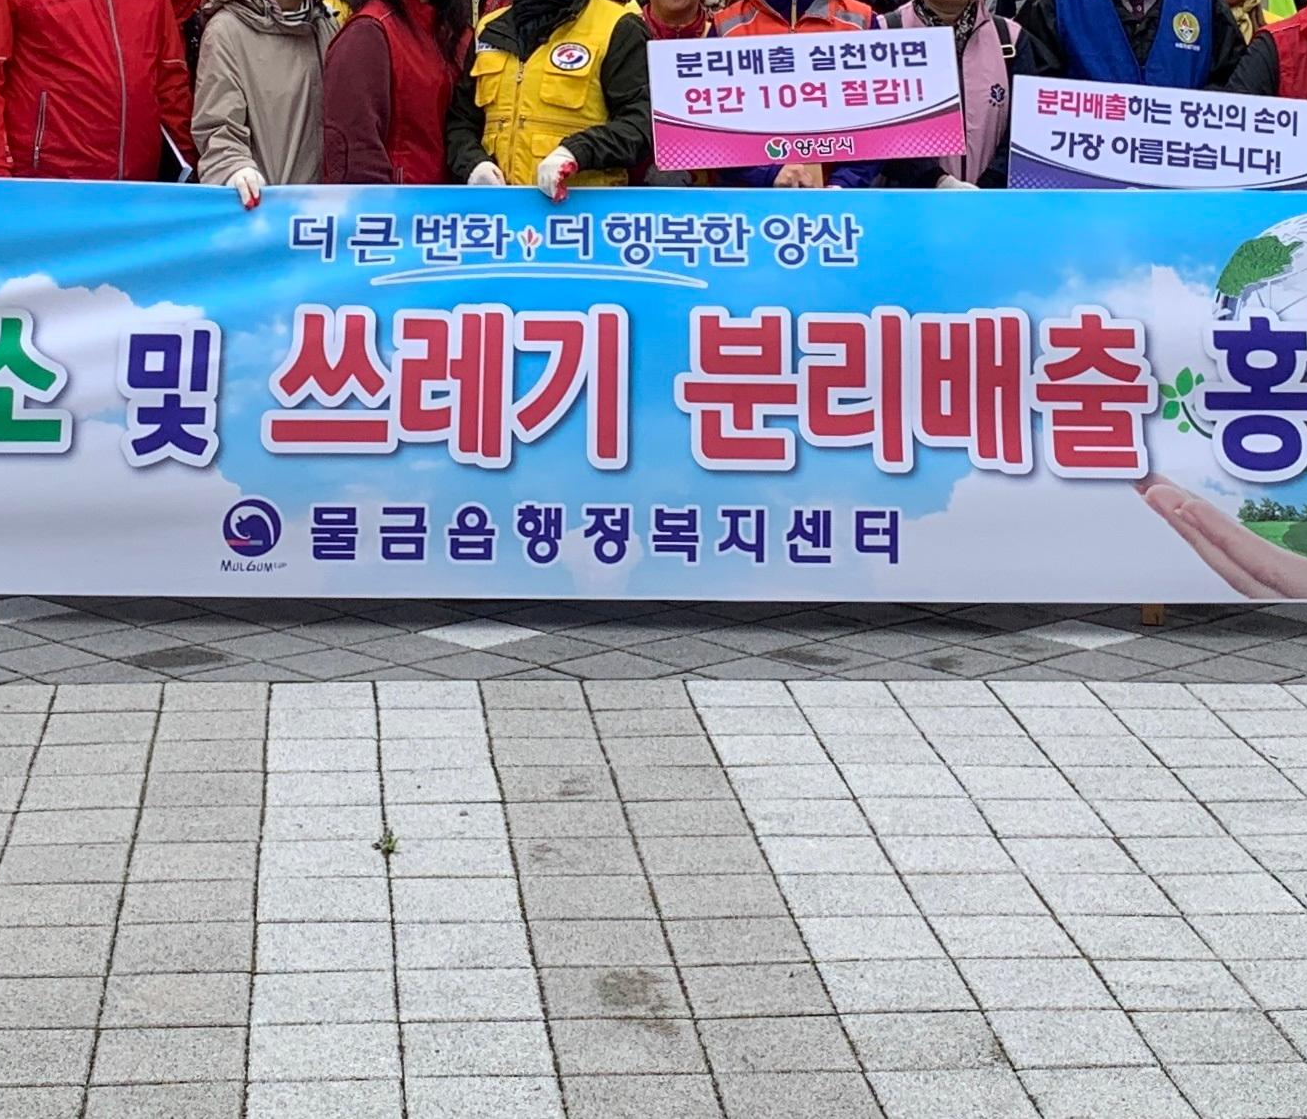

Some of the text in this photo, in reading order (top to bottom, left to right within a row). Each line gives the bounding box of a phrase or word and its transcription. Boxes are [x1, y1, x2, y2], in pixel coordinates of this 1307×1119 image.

[676, 40, 928, 78] 분리배출 실천하면
[684, 78, 924, 115] 연간 10억 절감!!
[1037, 88, 1298, 137] 분리배출하는 당신의 손이
[794, 137, 854, 156] 양산시
[1050, 130, 1282, 175] 가장 아름답습니다!
[292, 214, 860, 266] 더 큰 변화 더 행복한 양산
[126, 329, 212, 458] 및
[270, 312, 619, 460] 쓰레기
[683, 312, 1150, 469] 분리배출
[310, 504, 899, 565] 물금읍행정복지센터
